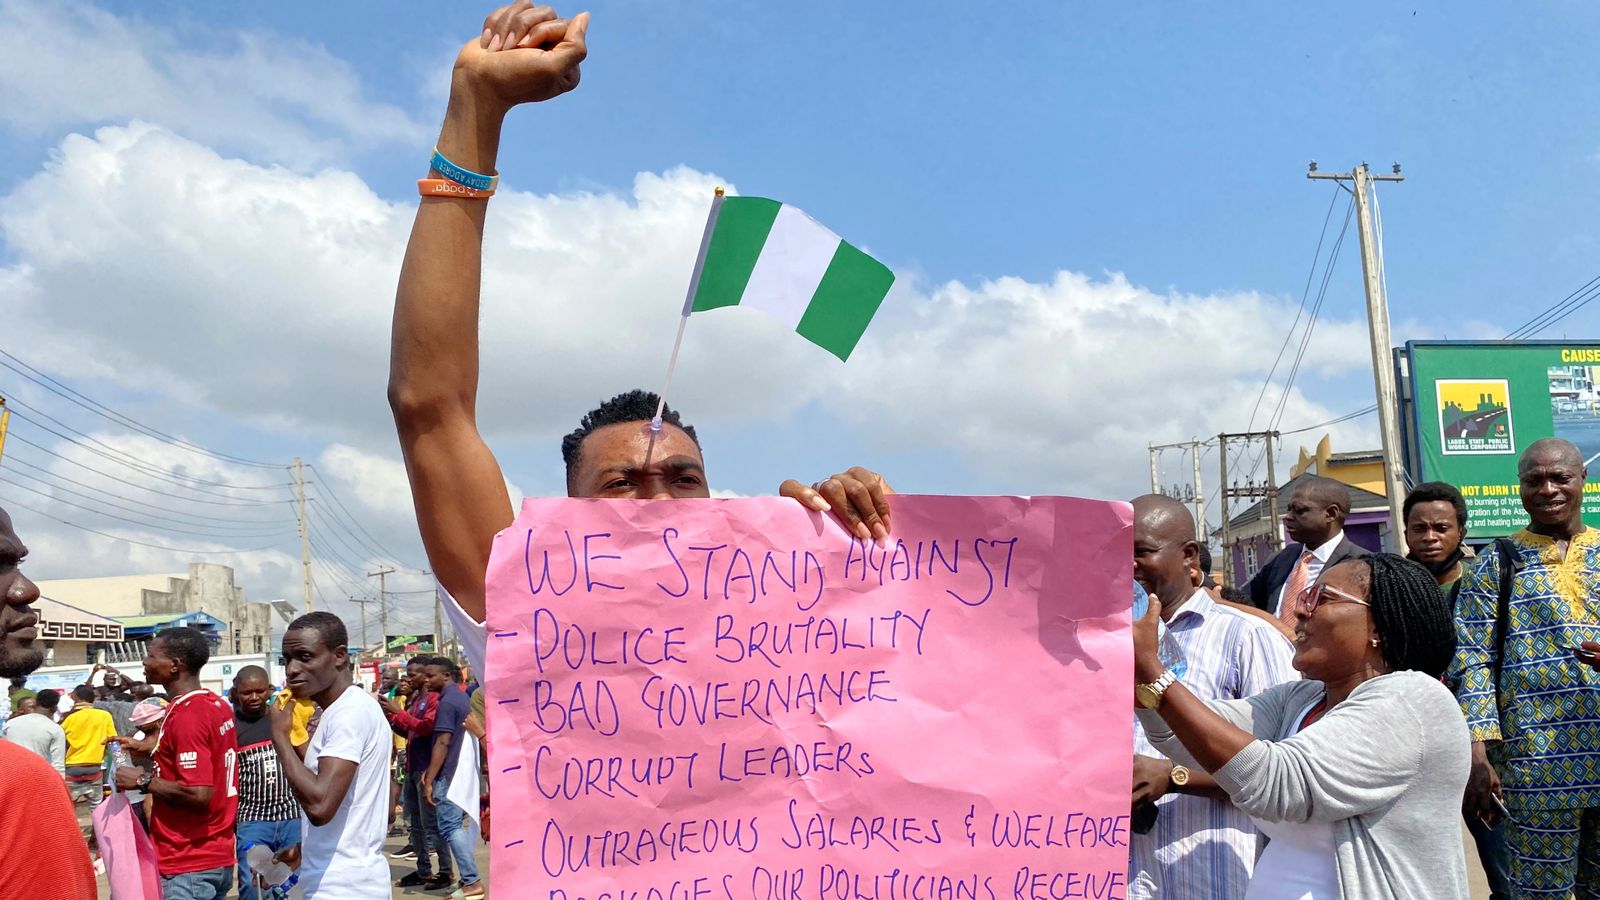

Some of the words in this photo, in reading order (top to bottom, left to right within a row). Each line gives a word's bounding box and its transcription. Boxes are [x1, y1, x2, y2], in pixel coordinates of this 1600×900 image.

[1561, 349, 1600, 362] CAUSE
[1461, 485, 1480, 496] NOT
[1482, 484, 1509, 496] BURN
[1474, 497, 1499, 507] burning
[1500, 497, 1507, 505] of
[1474, 519, 1486, 527] and
[1487, 518, 1511, 528] heating
[1511, 517, 1530, 526] takes
[1493, 508, 1500, 516] of
[1501, 508, 1512, 516] the
[525, 529, 625, 596] WE
[656, 527, 824, 611] STAND
[844, 535, 1018, 606] AGAINST
[534, 608, 687, 673] POLICE
[716, 609, 931, 668] BRUTALITY
[533, 680, 620, 736] BAD
[641, 670, 898, 728] GOVERNANCE
[534, 745, 699, 800] CORRUPT
[541, 816, 758, 877] OUTRAGEOUS
[781, 799, 942, 852] SALARIES
[991, 809, 1130, 849] WELFARE
[752, 866, 804, 900] OUR
[819, 863, 995, 900] POLITICIANS
[1013, 866, 1124, 900] RECEIVE
